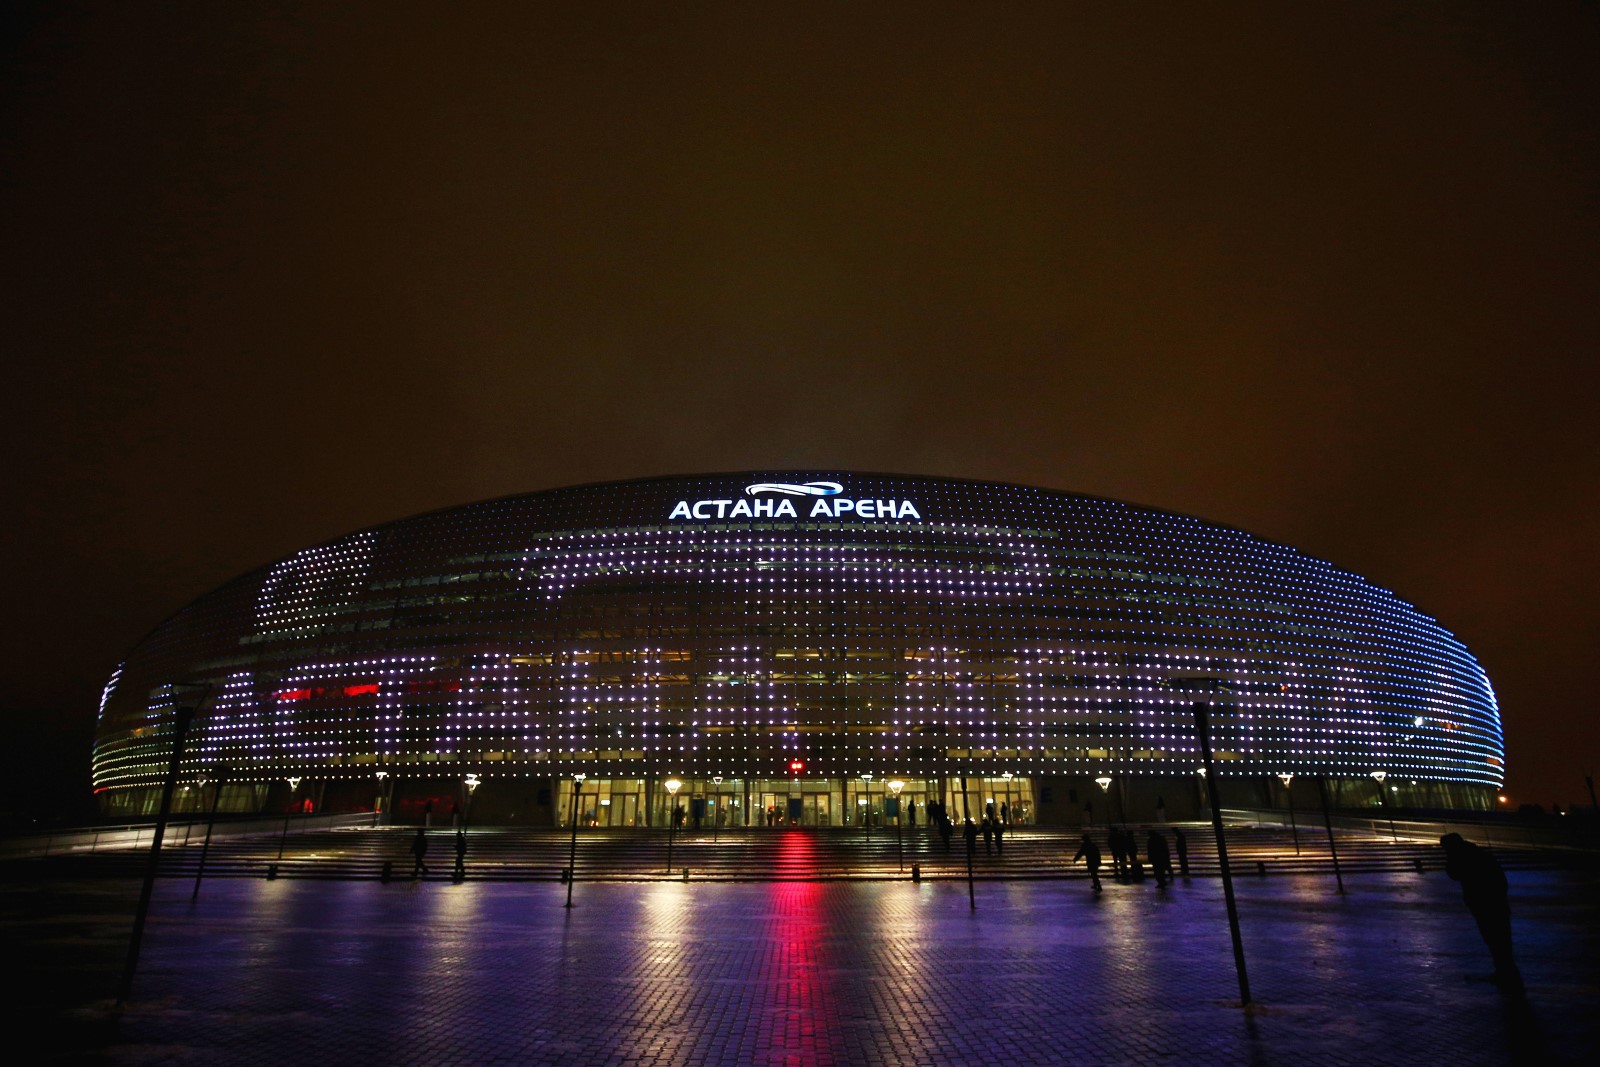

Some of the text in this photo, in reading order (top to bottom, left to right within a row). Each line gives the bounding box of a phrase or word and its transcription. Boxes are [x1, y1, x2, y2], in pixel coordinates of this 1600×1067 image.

[668, 498, 921, 520] АСТАНА АРЕНА
[200, 645, 799, 763] АСТАНА
[881, 646, 1387, 754] АРЕНА
